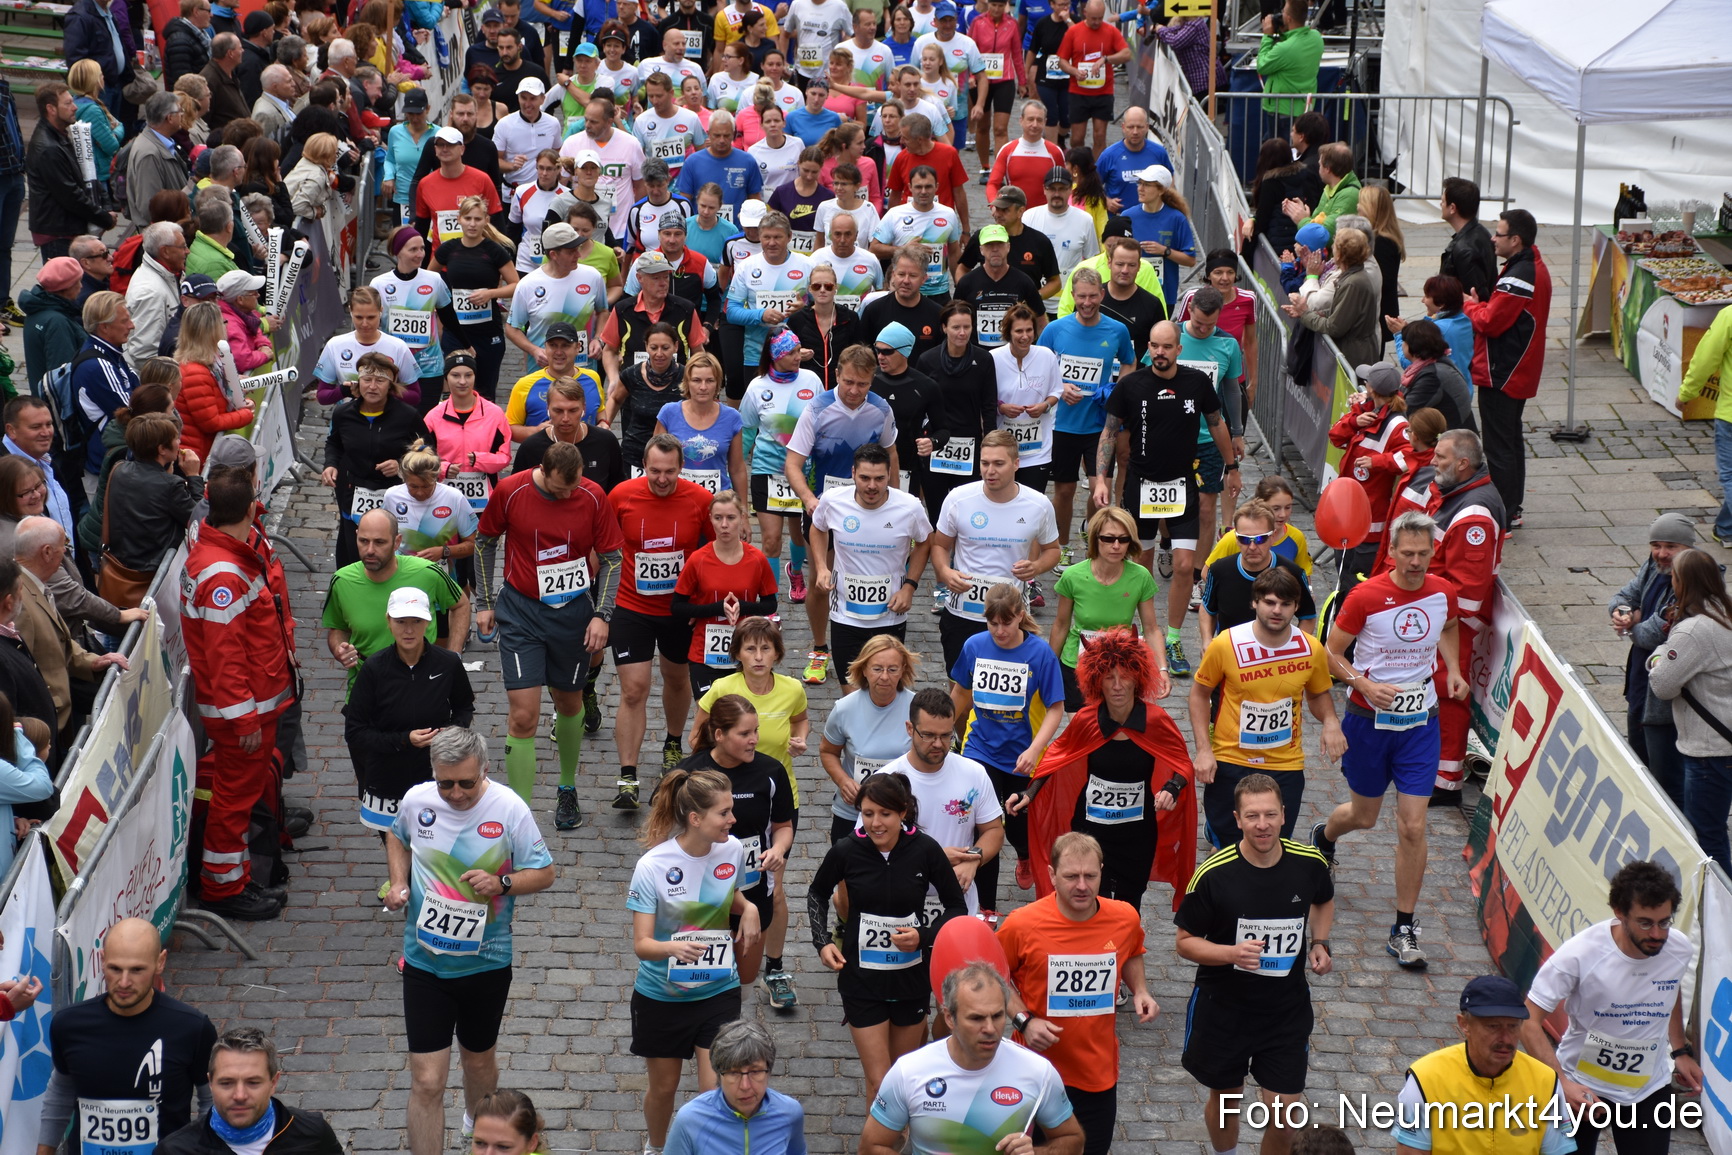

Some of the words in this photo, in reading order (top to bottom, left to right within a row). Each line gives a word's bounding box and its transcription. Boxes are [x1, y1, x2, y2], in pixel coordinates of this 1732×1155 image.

[802, 50, 816, 60] 232
[656, 144, 682, 157] 2616
[792, 238, 813, 250] 174
[268, 235, 278, 278] Laufsport
[287, 262, 299, 285] BMW
[266, 282, 274, 306] BMW
[394, 319, 427, 334] 2308
[1063, 364, 1098, 381] 2577
[262, 374, 283, 386] BMW
[1150, 488, 1177, 502] 330
[557, 564, 579, 572] Neumarkt
[640, 562, 681, 579] 2634
[544, 570, 585, 594] 2473
[848, 584, 887, 602] 3028
[994, 665, 1019, 673] Neumarkt
[1240, 667, 1274, 683] MAX
[1278, 660, 1313, 675] BÖGL
[977, 671, 1022, 694] 3033
[1382, 694, 1424, 712] 223
[1246, 710, 1288, 731] 2782
[1390, 716, 1417, 724] Rüdiger
[1257, 735, 1279, 743] Marco
[1091, 780, 1106, 790] PARTL
[1092, 790, 1140, 807] 2257
[481, 825, 502, 834] Hervis
[716, 867, 733, 877] Hervis
[425, 896, 443, 909] PARTL
[444, 904, 476, 915] Neumarkt
[423, 907, 479, 938] 2477
[862, 919, 881, 927] PARTL
[1239, 923, 1261, 931] PARTL
[432, 937, 461, 950] Gerald
[886, 954, 898, 962] Evi
[1260, 959, 1278, 968] Toni
[690, 972, 710, 980] Julia
[1055, 969, 1111, 992] 2827
[1068, 998, 1096, 1008] Stefan
[1588, 1033, 1613, 1048] PARTL
[1596, 1048, 1645, 1074] 532
[995, 1091, 1019, 1101] Hervis
[81, 1103, 102, 1113] PARTL
[87, 1115, 150, 1142] 2599
